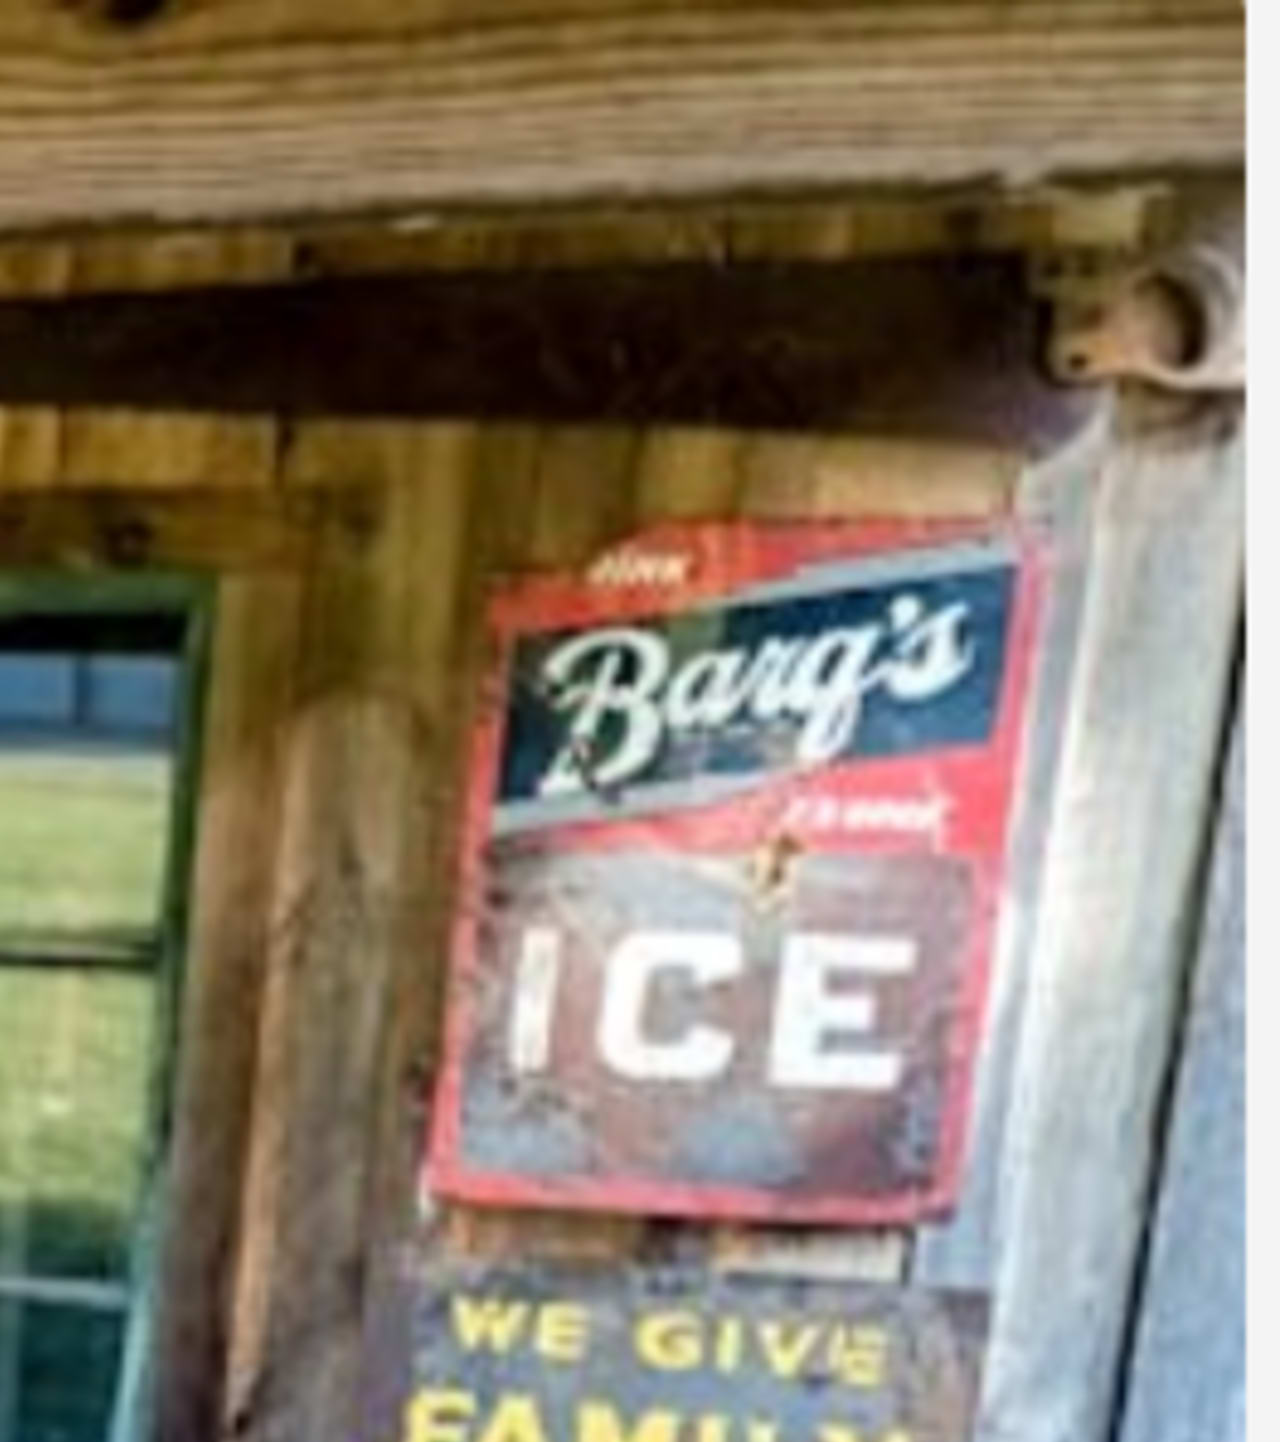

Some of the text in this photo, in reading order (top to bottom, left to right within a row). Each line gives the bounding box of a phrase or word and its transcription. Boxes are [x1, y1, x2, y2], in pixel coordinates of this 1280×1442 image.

[506, 926, 918, 1089] ICE
[451, 1293, 890, 1388] WE GIVE
